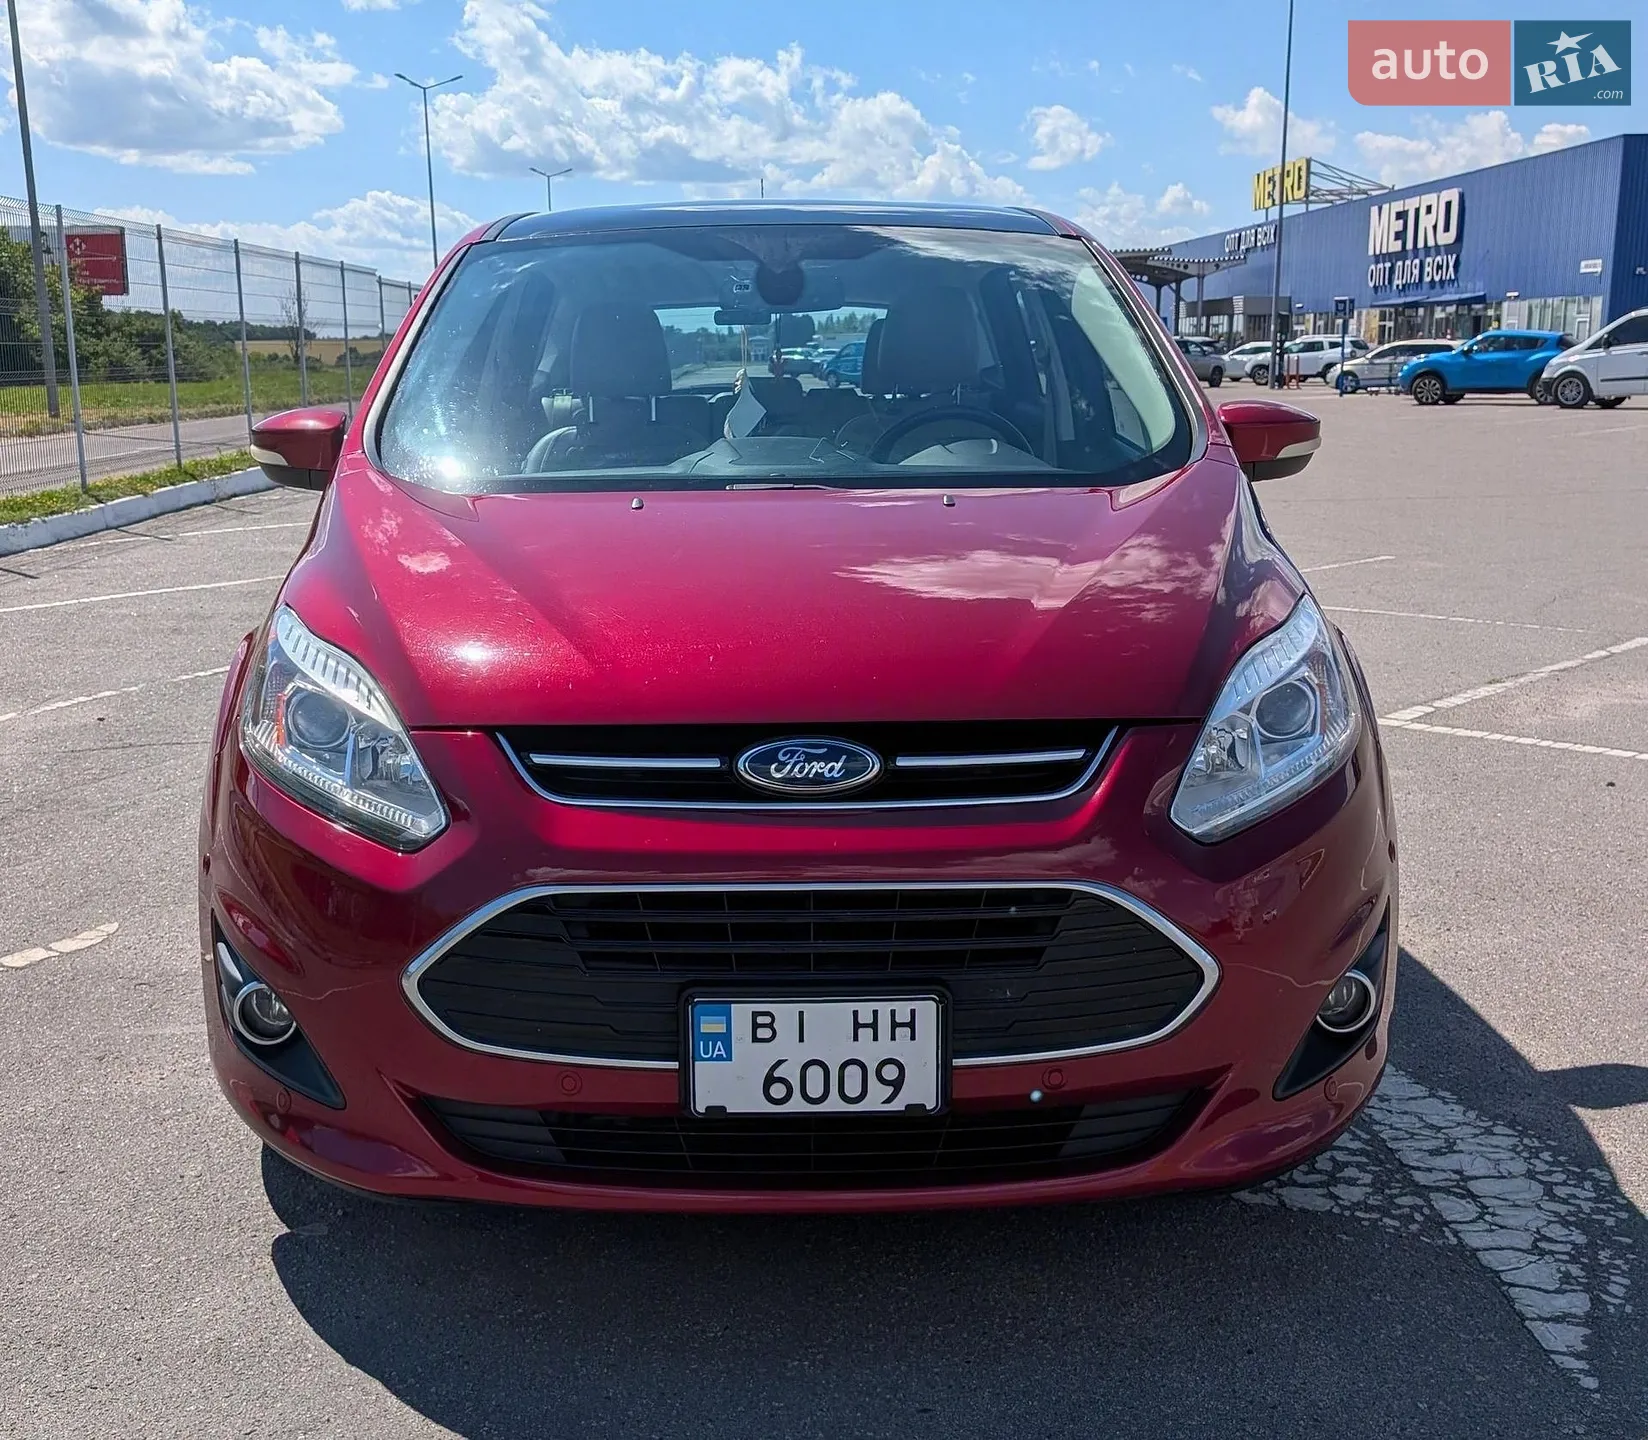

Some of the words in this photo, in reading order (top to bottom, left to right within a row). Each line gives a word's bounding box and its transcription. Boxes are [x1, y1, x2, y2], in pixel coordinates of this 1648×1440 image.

[1251, 157, 1307, 212] METRO
[1368, 188, 1461, 256] METRO
[1368, 262, 1391, 288] ОПТ
[1394, 258, 1420, 290] ДЛЯ
[1424, 253, 1457, 282] ВСІХ
[770, 747, 847, 778] Ford
[852, 1008, 916, 1042] HH
[700, 1041, 726, 1058] UA
[762, 1057, 906, 1106] 6009
